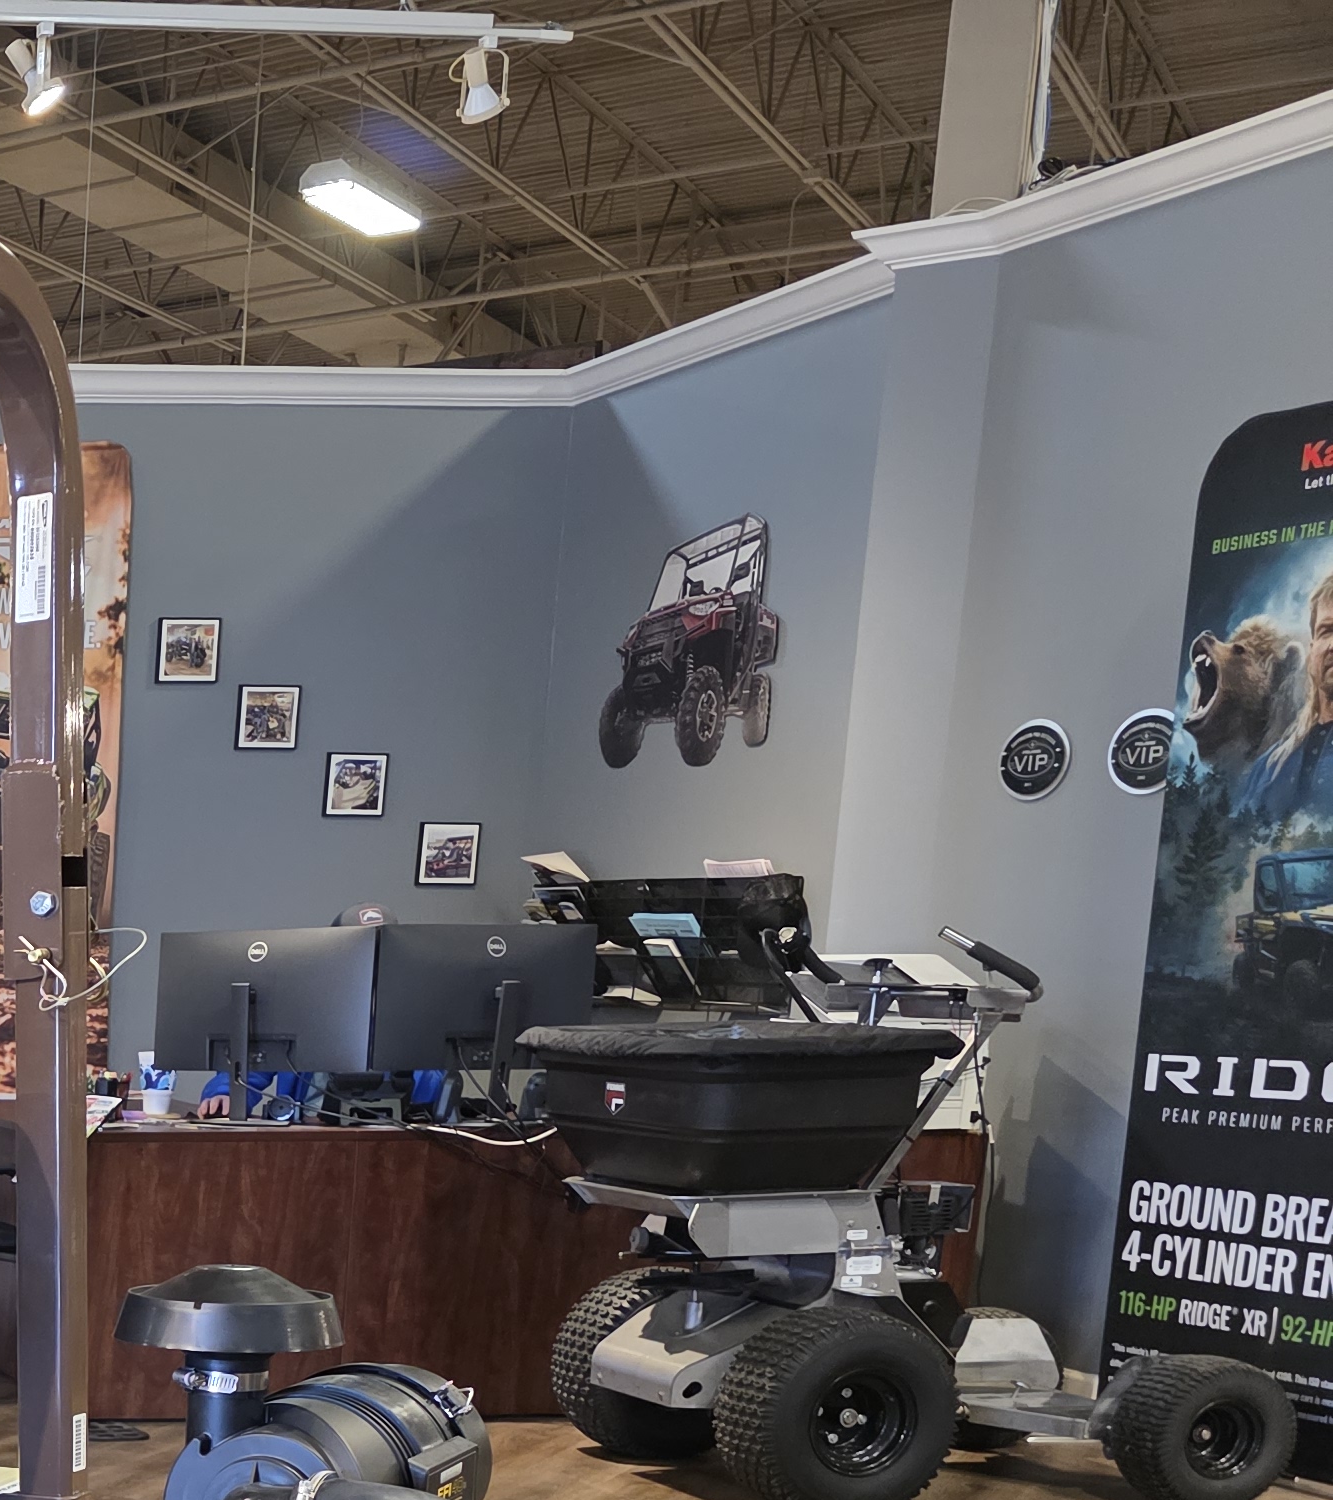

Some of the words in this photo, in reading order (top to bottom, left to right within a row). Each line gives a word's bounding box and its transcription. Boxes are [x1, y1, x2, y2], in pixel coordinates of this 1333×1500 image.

[1304, 476, 1323, 490] Let
[1212, 528, 1277, 555] BUSINESS
[1281, 525, 1295, 543] IN
[1300, 520, 1325, 539] THE
[1014, 754, 1048, 773] VIP
[1125, 746, 1164, 765] VIP
[1144, 1053, 1333, 1103] RID
[1161, 1107, 1200, 1125] PEAK
[1208, 1111, 1282, 1131] PREMIUM
[1129, 1180, 1256, 1234] GROUND
[1121, 1230, 1297, 1295] 4-CYLINDER
[1119, 1290, 1177, 1321] 116-HP
[1240, 1308, 1268, 1337] XR
